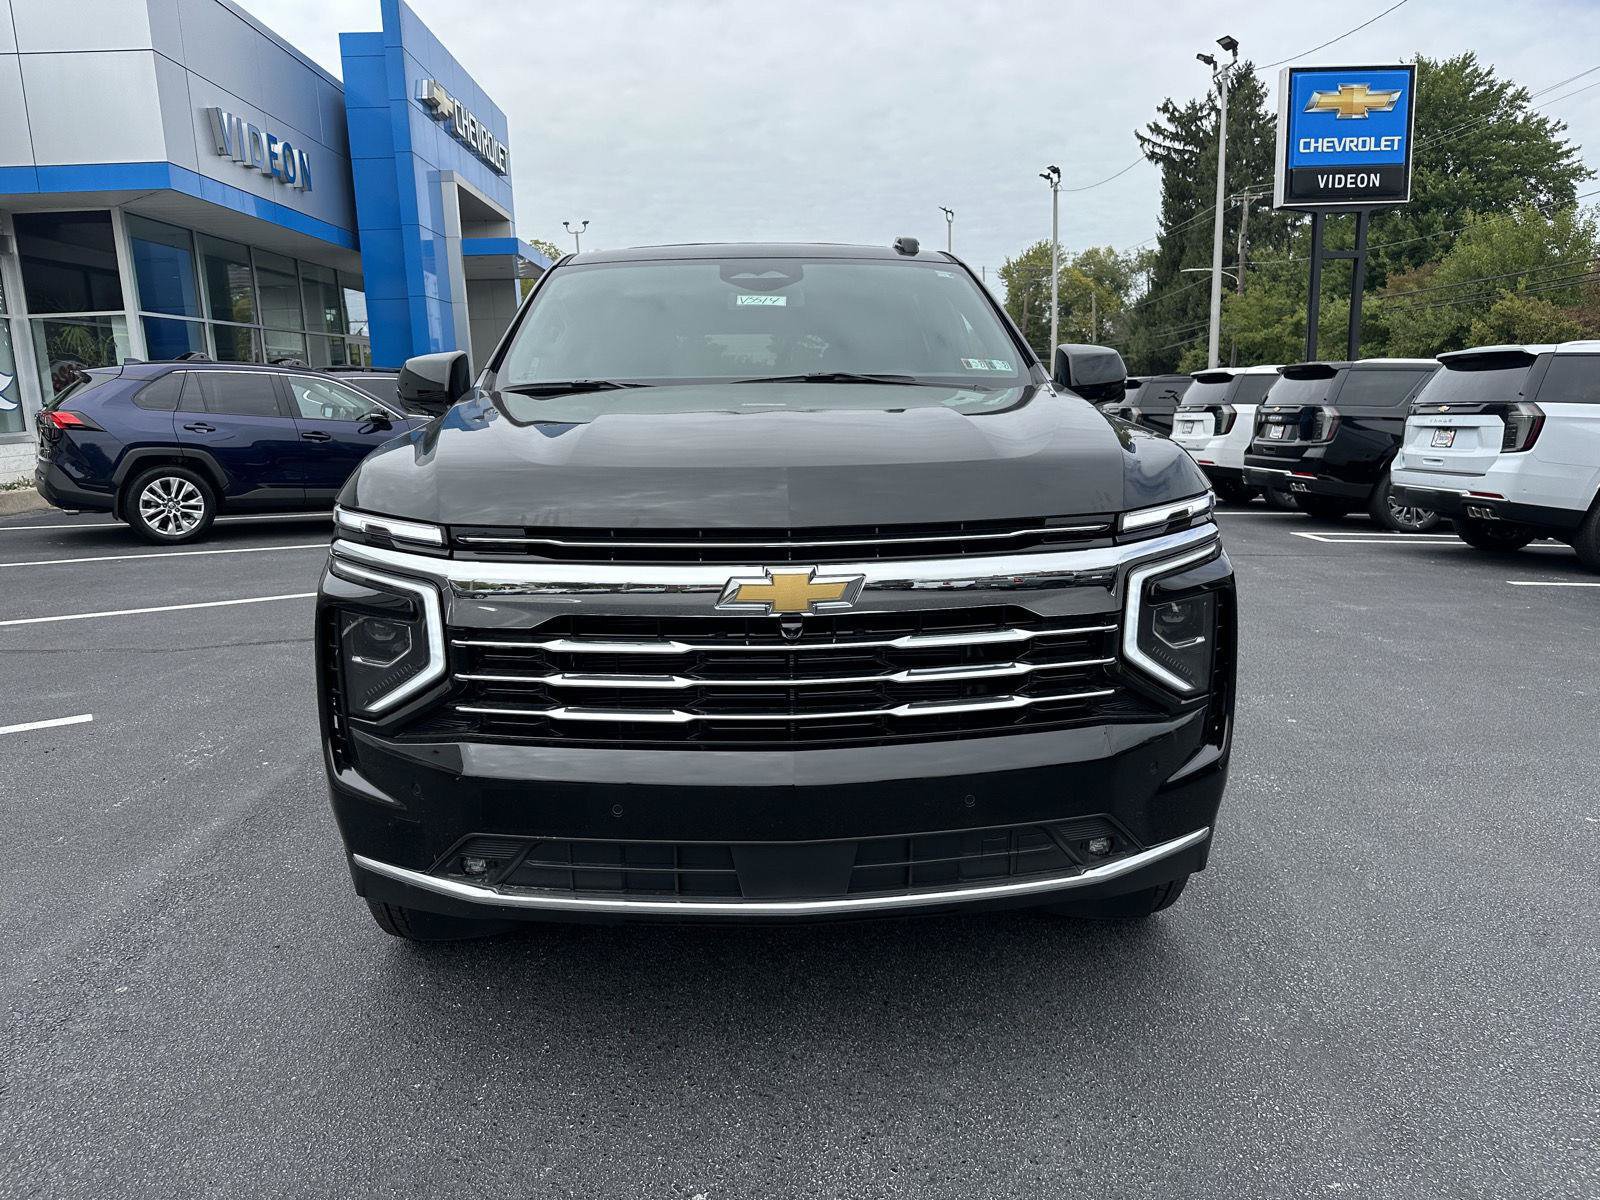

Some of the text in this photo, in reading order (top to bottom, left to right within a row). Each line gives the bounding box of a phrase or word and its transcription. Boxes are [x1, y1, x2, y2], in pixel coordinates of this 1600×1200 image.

[207, 106, 313, 192] VIDEON
[453, 97, 510, 175] CHEVROLET
[1299, 136, 1402, 153] CHEVROLET
[1317, 173, 1381, 189] VIDEON
